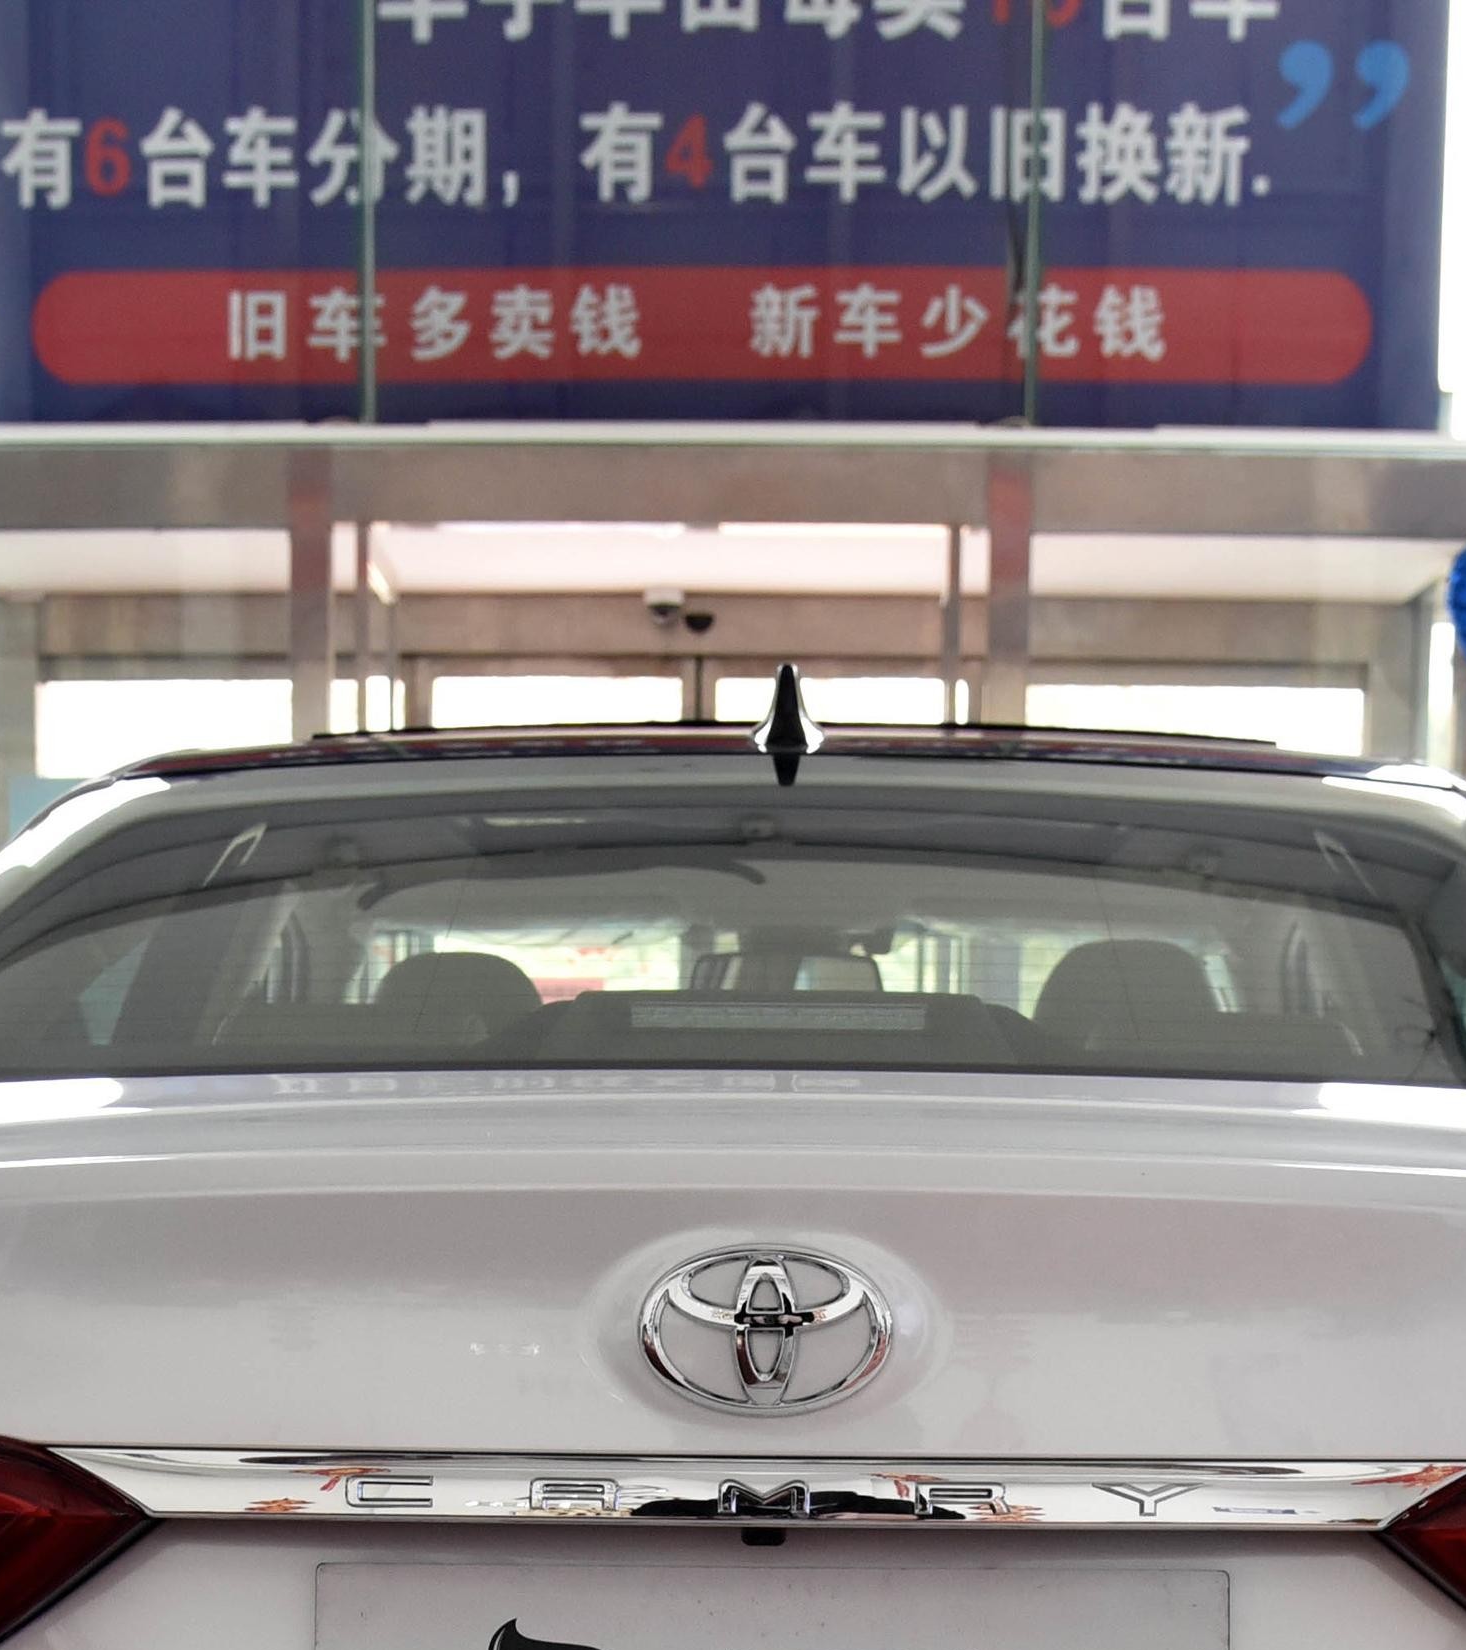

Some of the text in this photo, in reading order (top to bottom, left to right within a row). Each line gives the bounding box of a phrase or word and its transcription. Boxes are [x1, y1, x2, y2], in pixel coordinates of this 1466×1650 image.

[226, 284, 1169, 362] 旧车多卖钱 新车少花钱
[344, 1474, 1206, 1518] CAMRY
